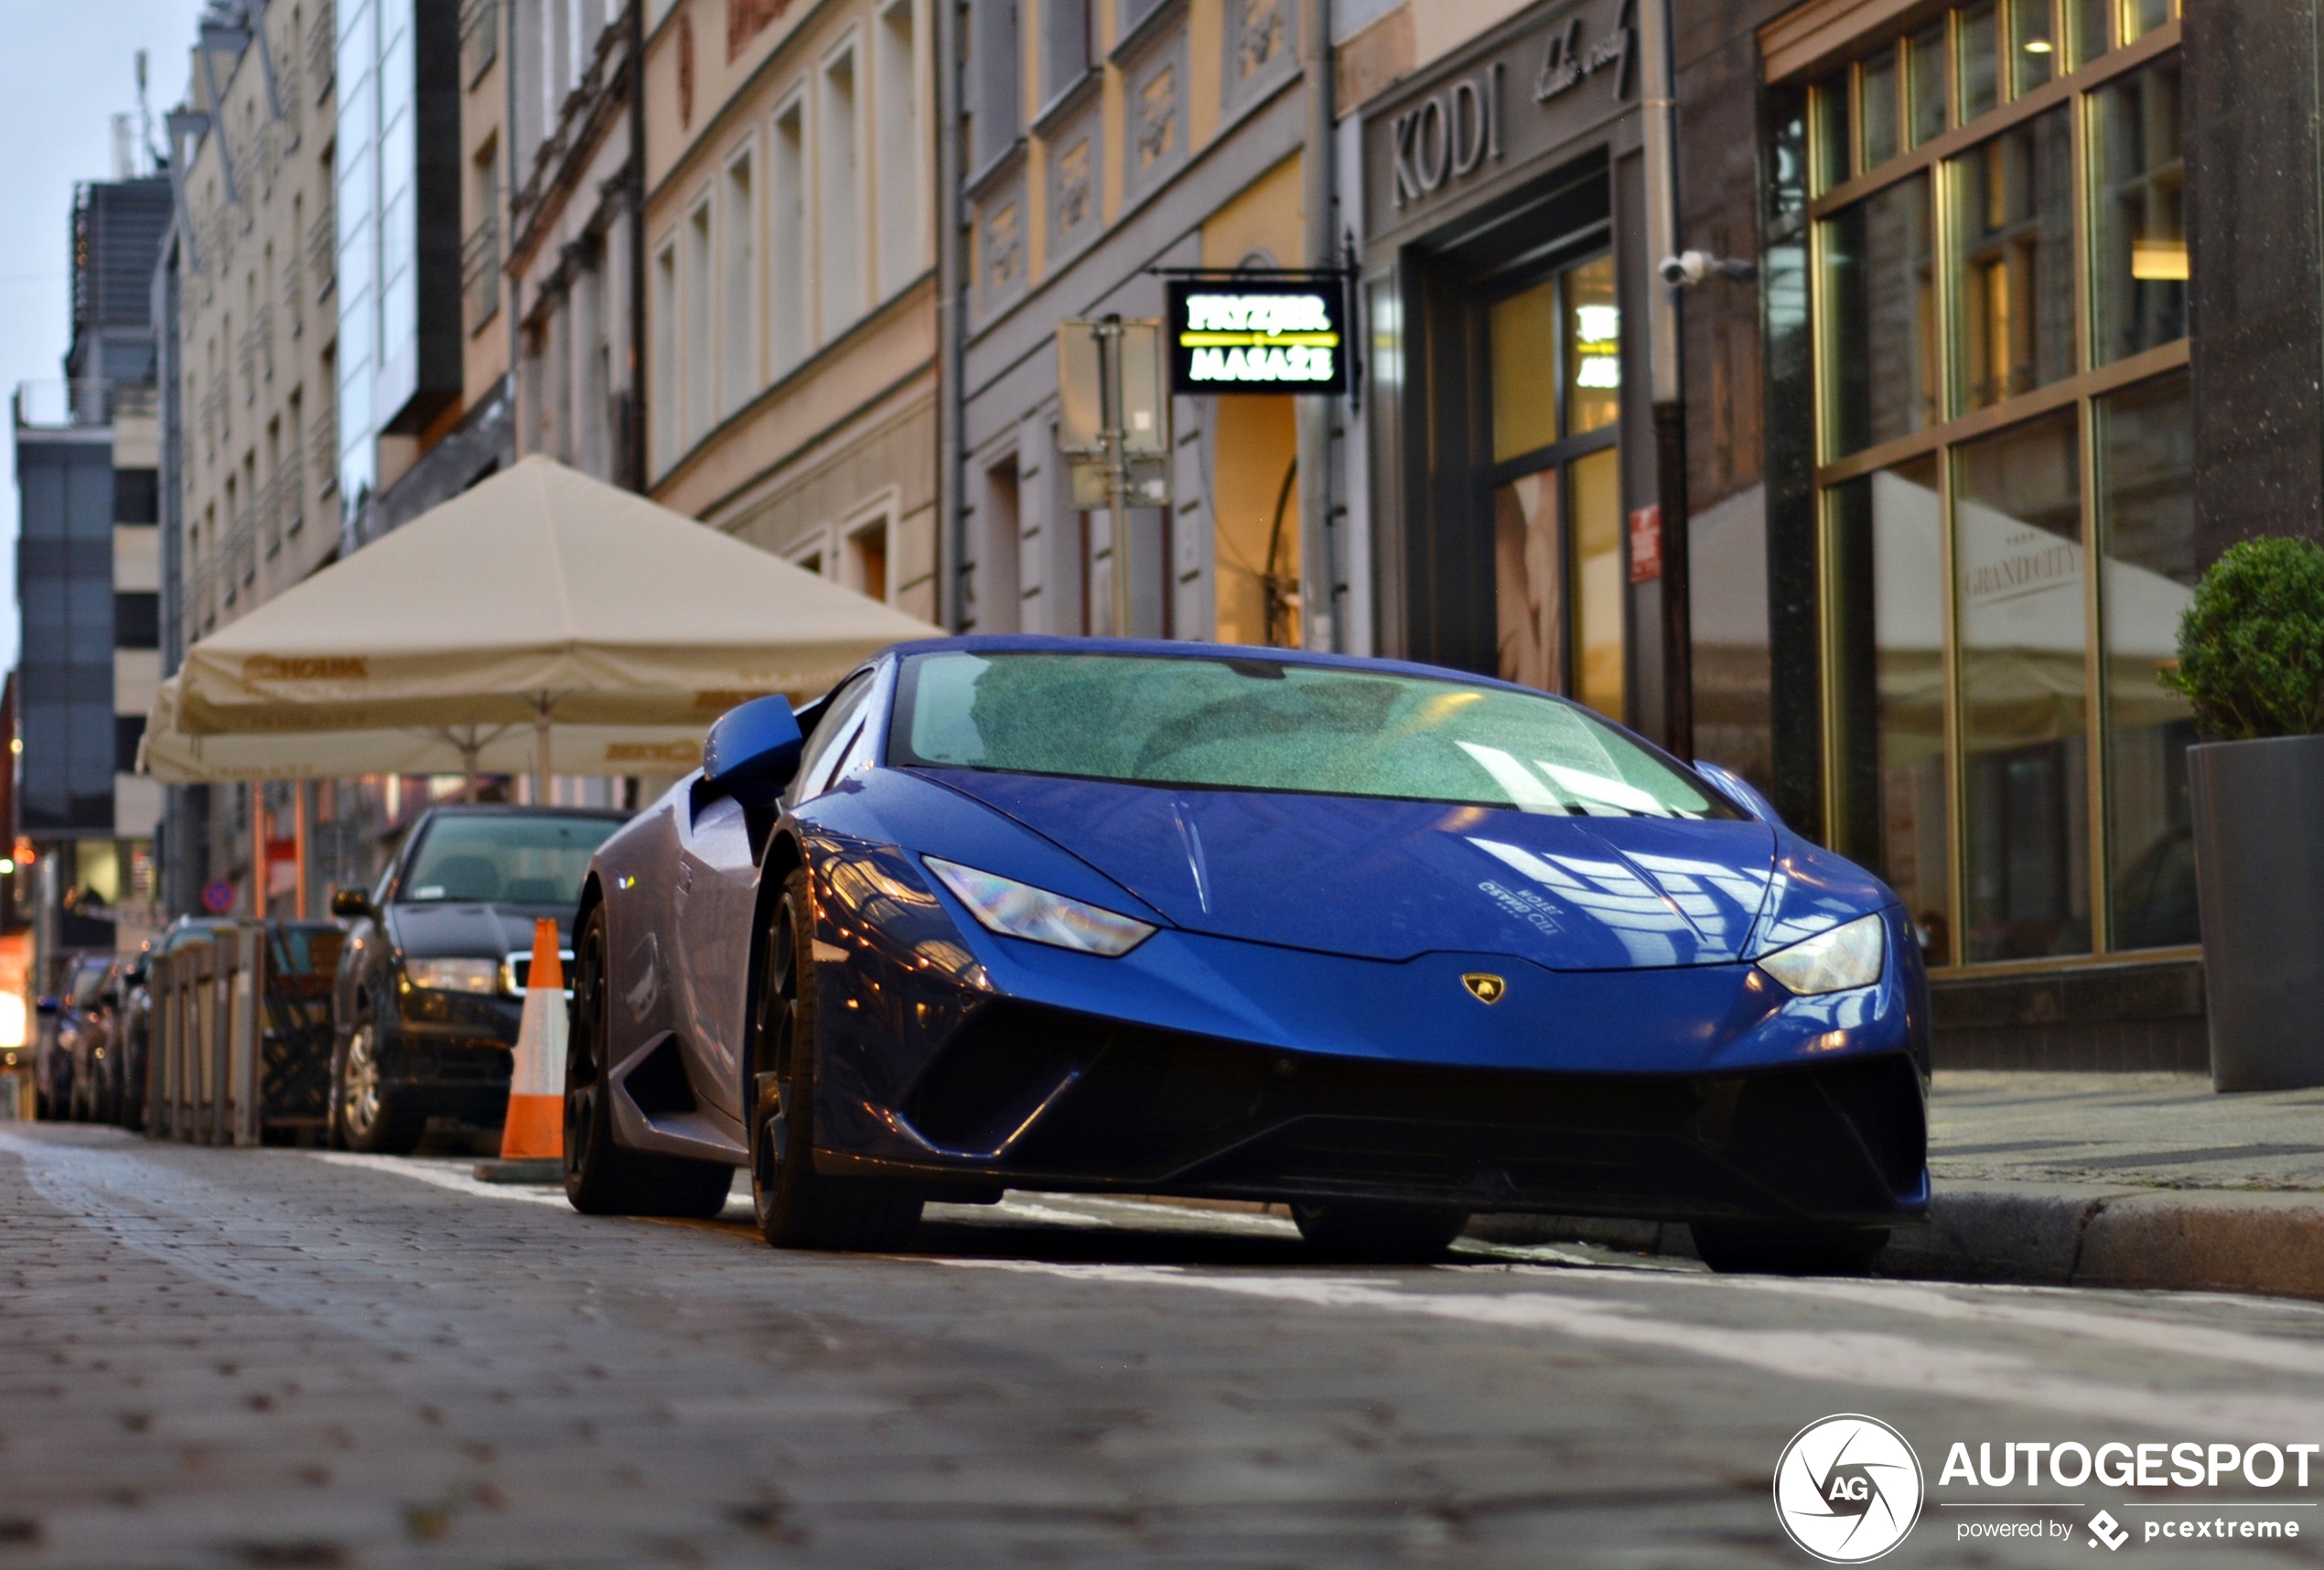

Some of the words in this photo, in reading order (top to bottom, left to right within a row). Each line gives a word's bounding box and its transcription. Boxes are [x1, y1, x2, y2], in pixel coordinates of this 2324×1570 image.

[1391, 61, 1505, 210] KODI
[1964, 554, 2030, 596] GRAND
[2032, 543, 2081, 577] CITY
